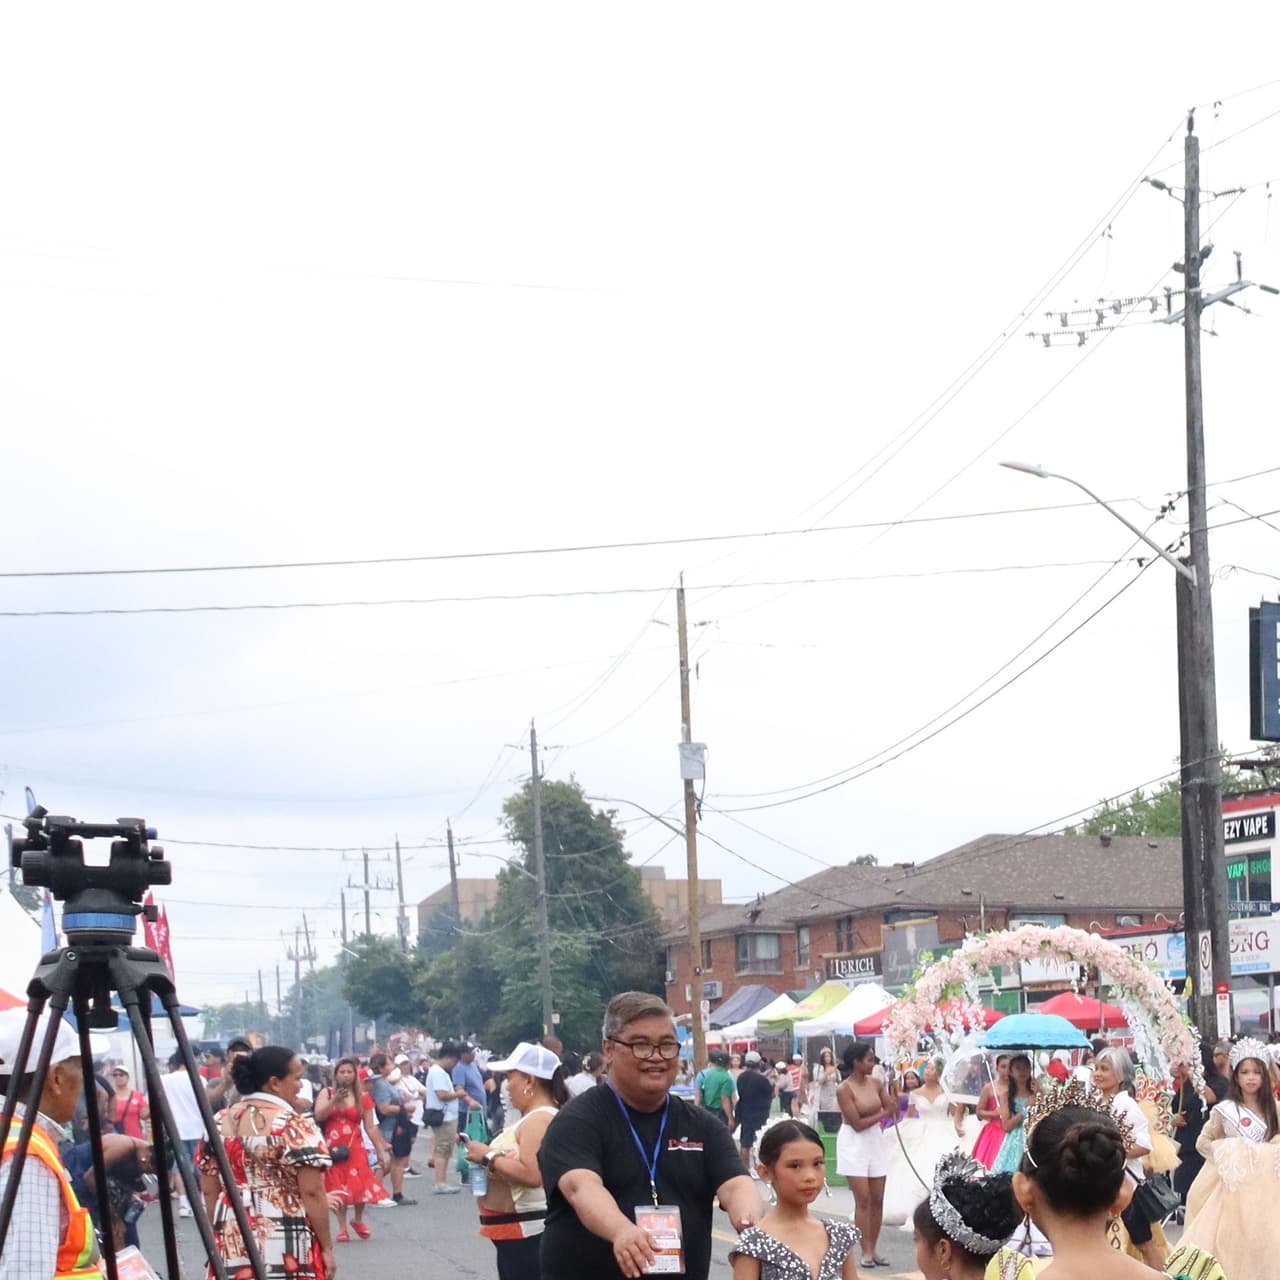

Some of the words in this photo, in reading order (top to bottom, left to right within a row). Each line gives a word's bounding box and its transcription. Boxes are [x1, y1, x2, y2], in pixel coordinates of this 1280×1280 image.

[1224, 819, 1242, 840] EZY
[1244, 815, 1268, 836] VAPE
[1251, 859, 1271, 874] SHO
[834, 957, 874, 978] LERICH
